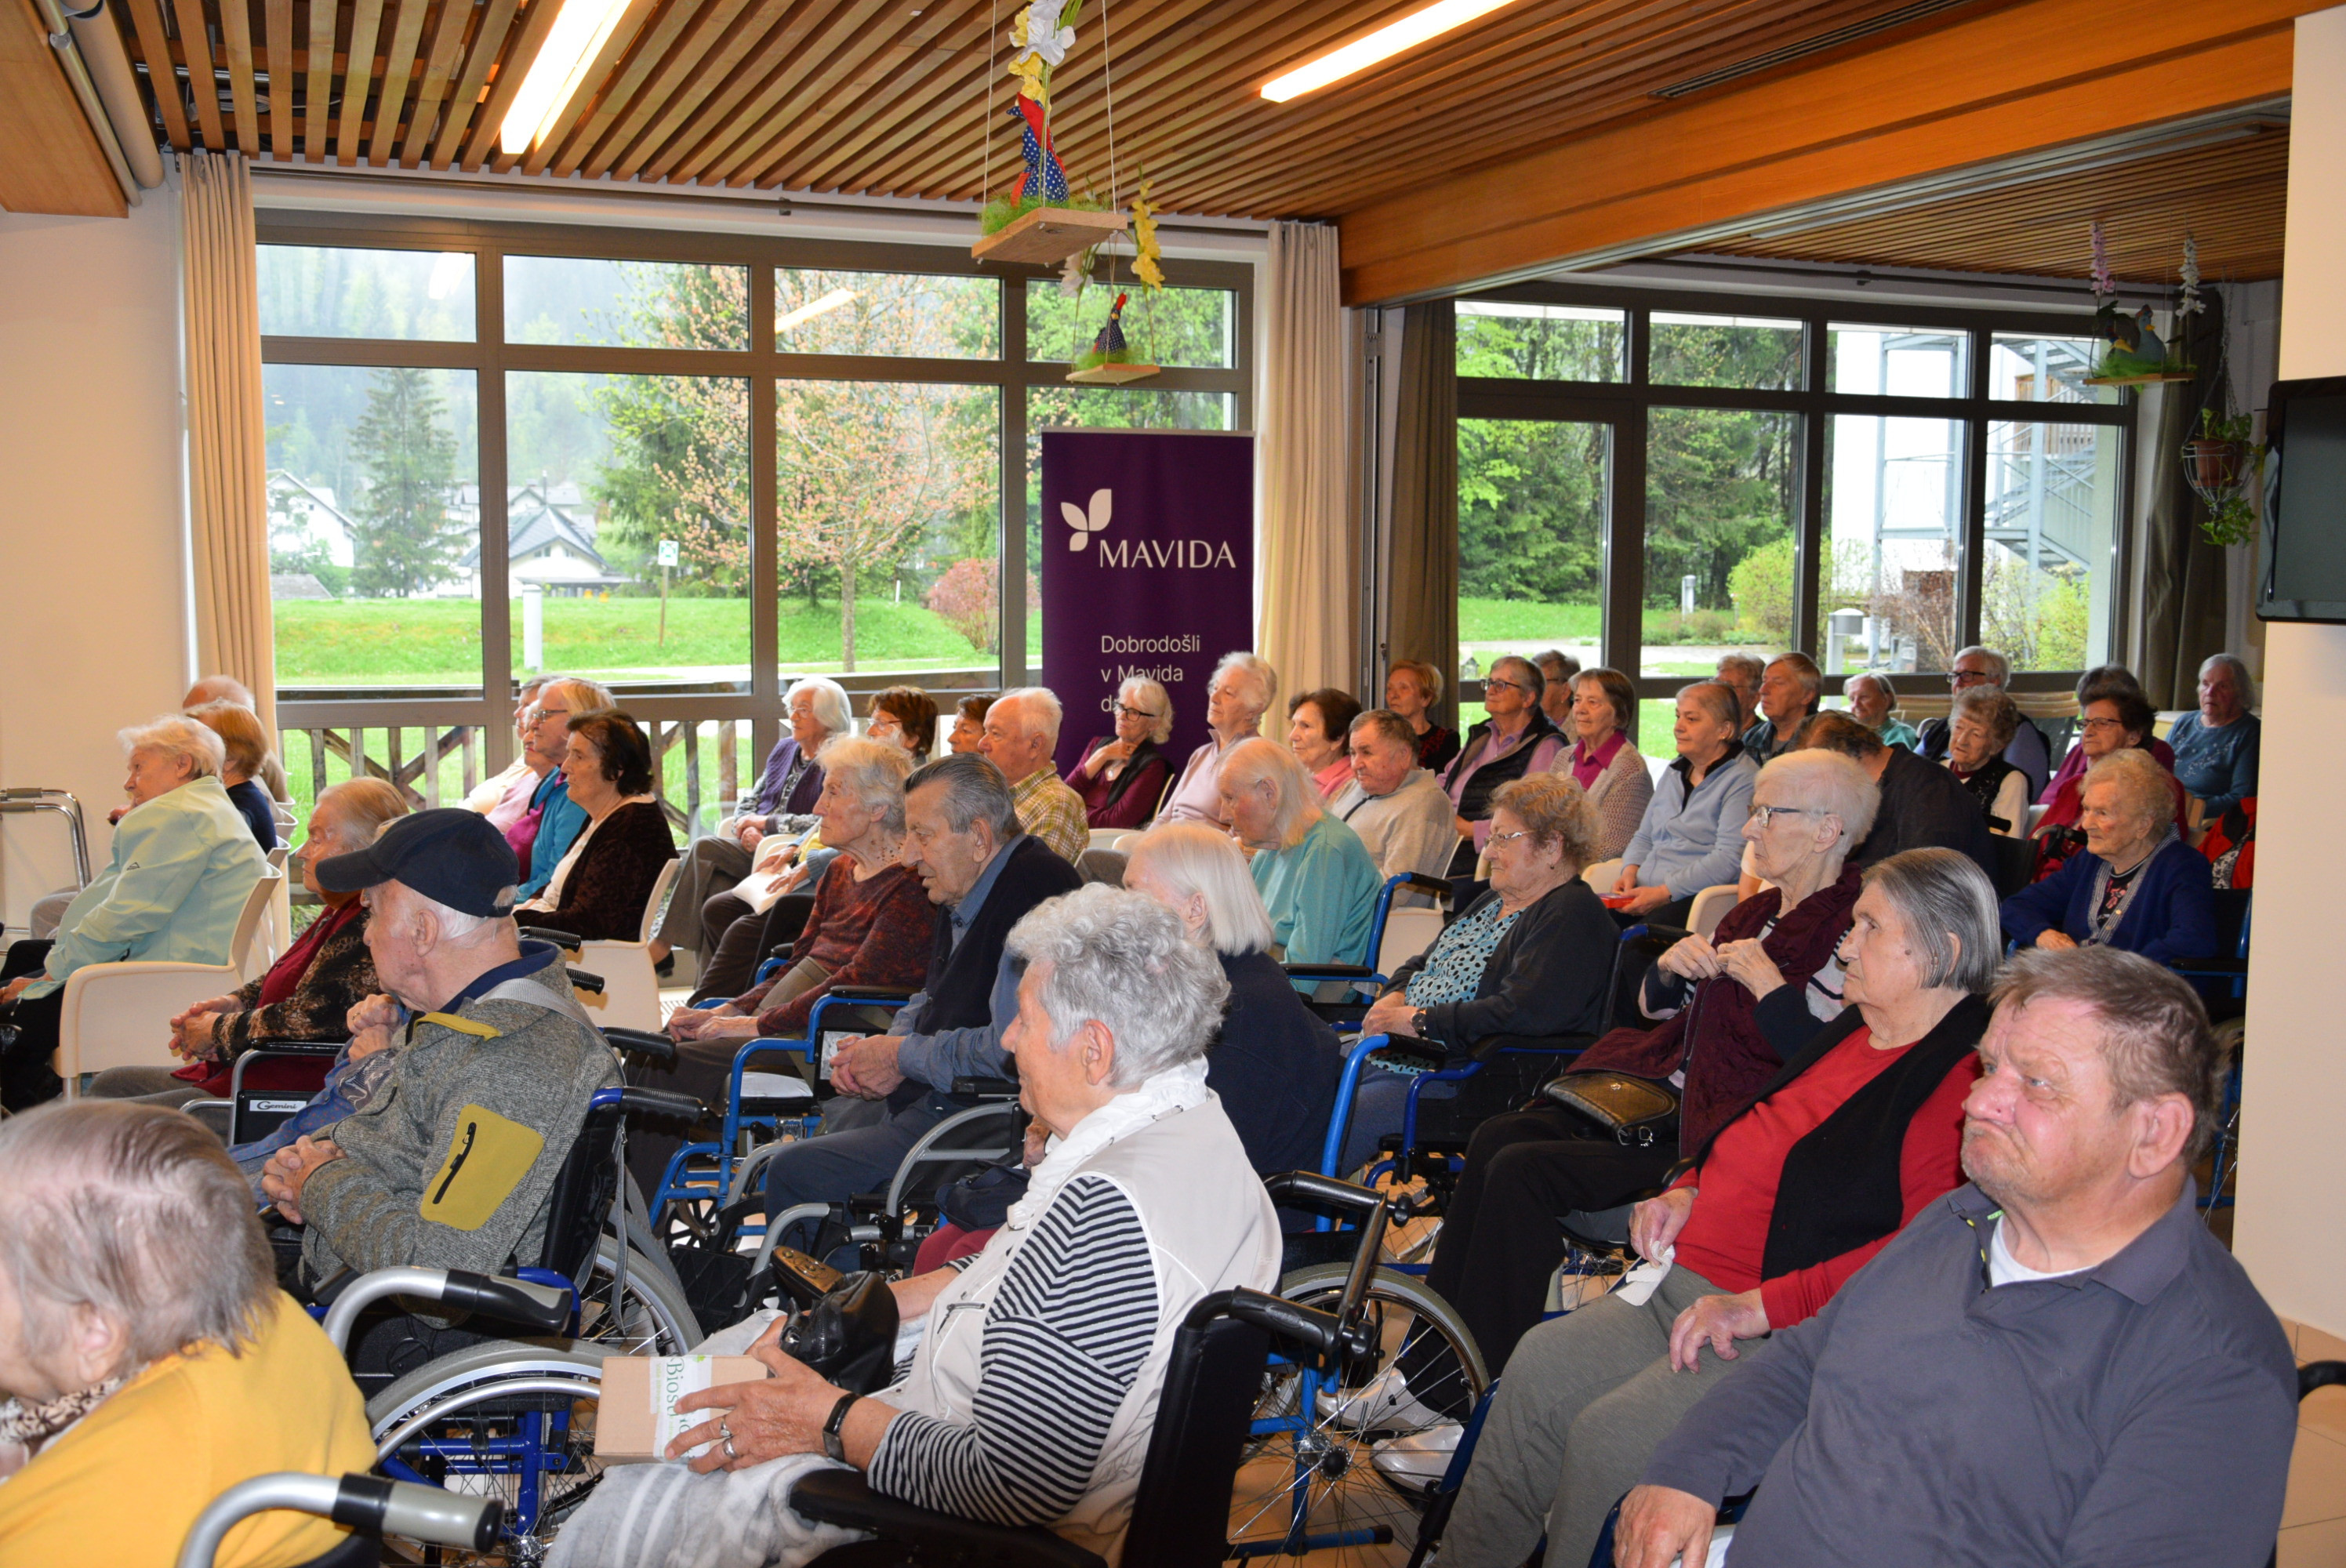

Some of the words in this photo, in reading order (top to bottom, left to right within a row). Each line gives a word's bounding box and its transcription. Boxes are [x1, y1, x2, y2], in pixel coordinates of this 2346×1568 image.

[1099, 539, 1237, 568] MAVIDA
[1101, 633, 1200, 653] Dobrodošli
[1100, 669, 1111, 682] v
[256, 1101, 296, 1110] Gemini
